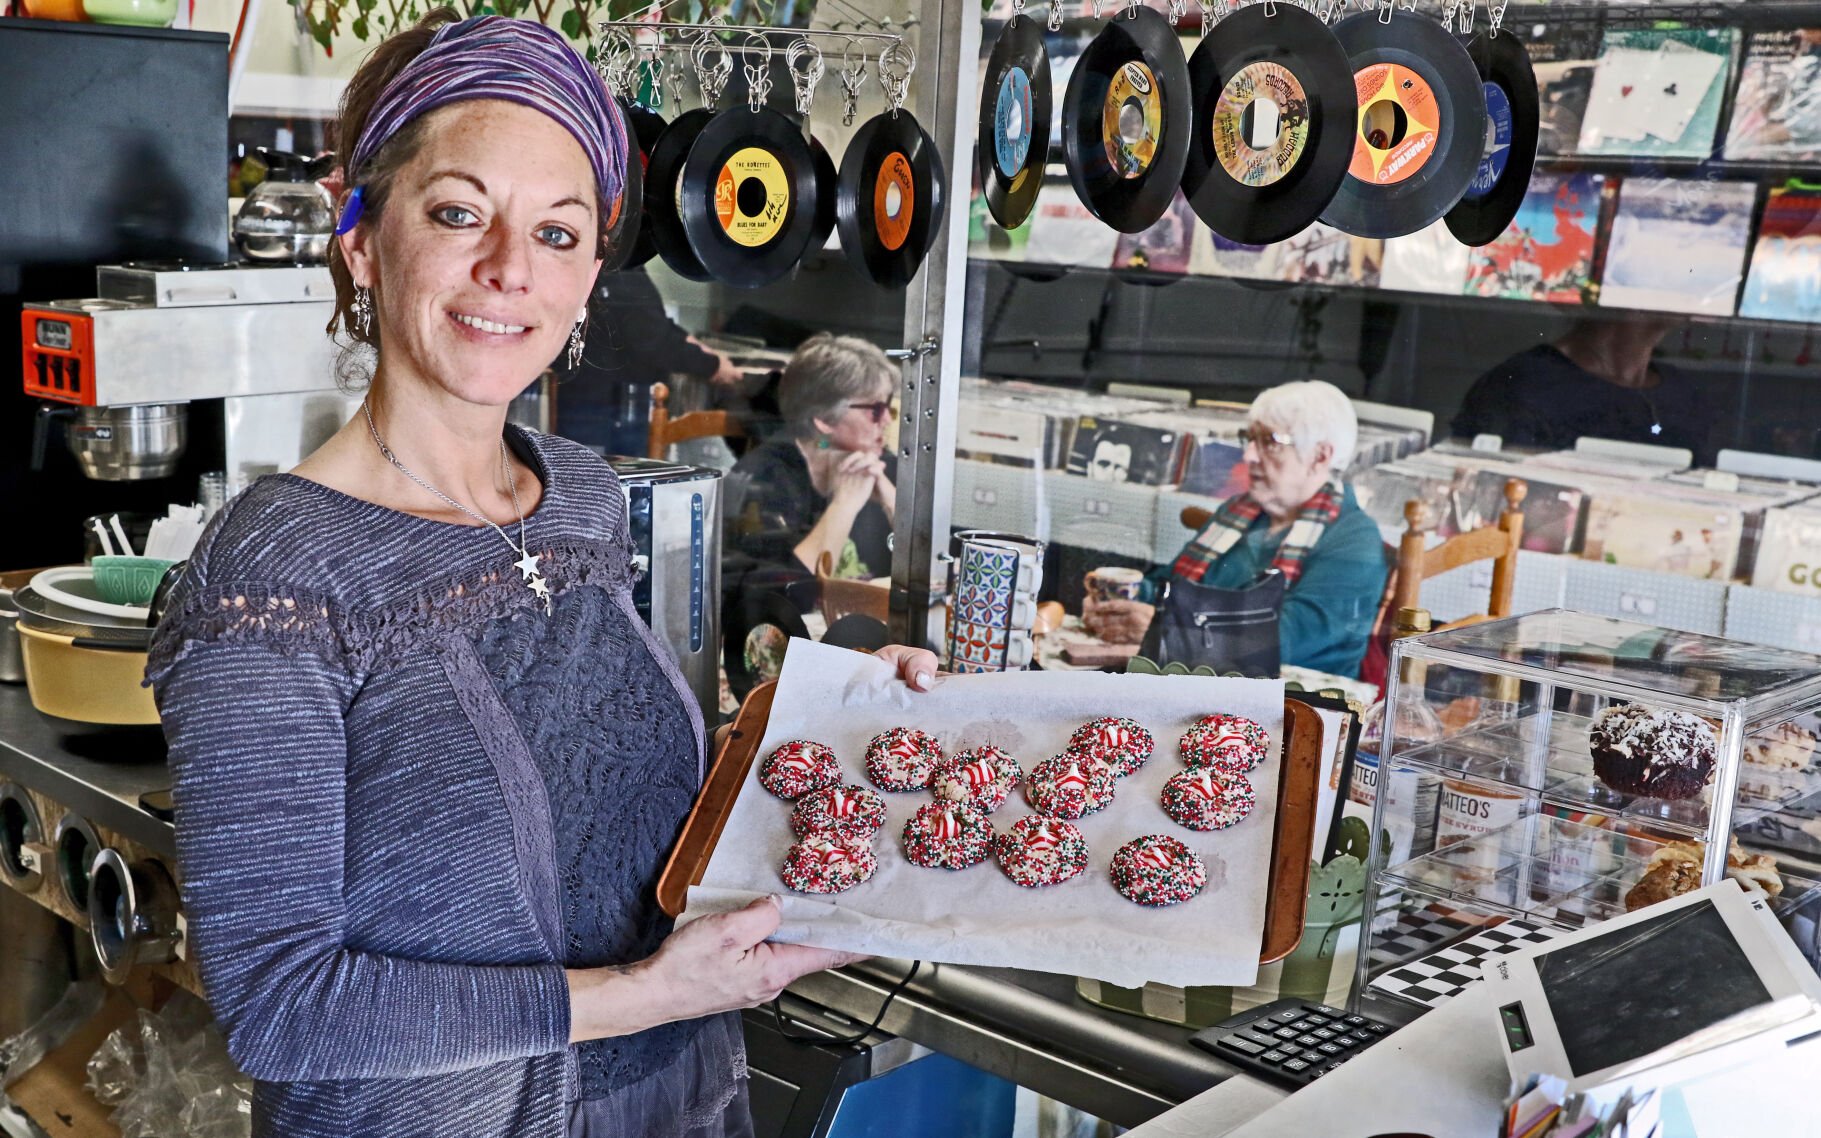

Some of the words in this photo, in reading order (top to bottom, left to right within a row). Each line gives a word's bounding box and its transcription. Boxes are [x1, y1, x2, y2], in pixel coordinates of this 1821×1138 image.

[1265, 74, 1295, 99] RECORDS
[1276, 132, 1299, 166] BUDDAH
[1388, 138, 1427, 176] PARKWAY
